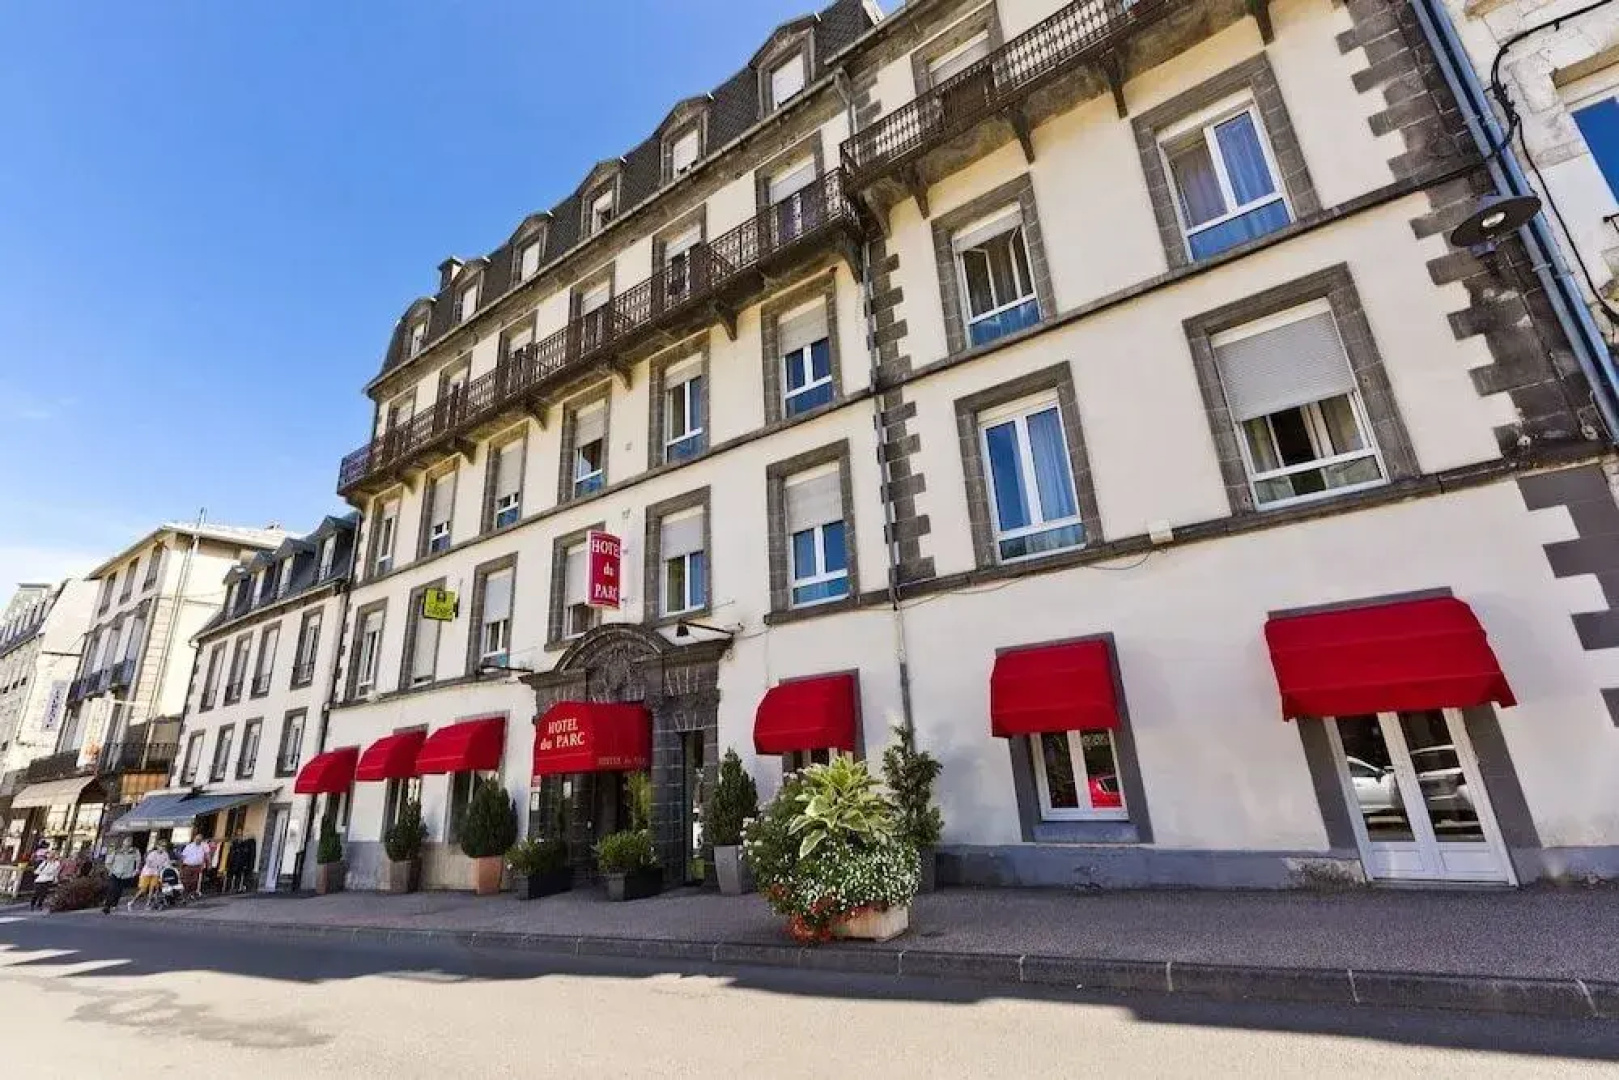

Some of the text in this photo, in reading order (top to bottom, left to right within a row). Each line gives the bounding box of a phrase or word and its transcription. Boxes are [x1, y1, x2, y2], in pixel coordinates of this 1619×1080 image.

[548, 718, 578, 735] HOTEL
[541, 732, 585, 750] du PARC
